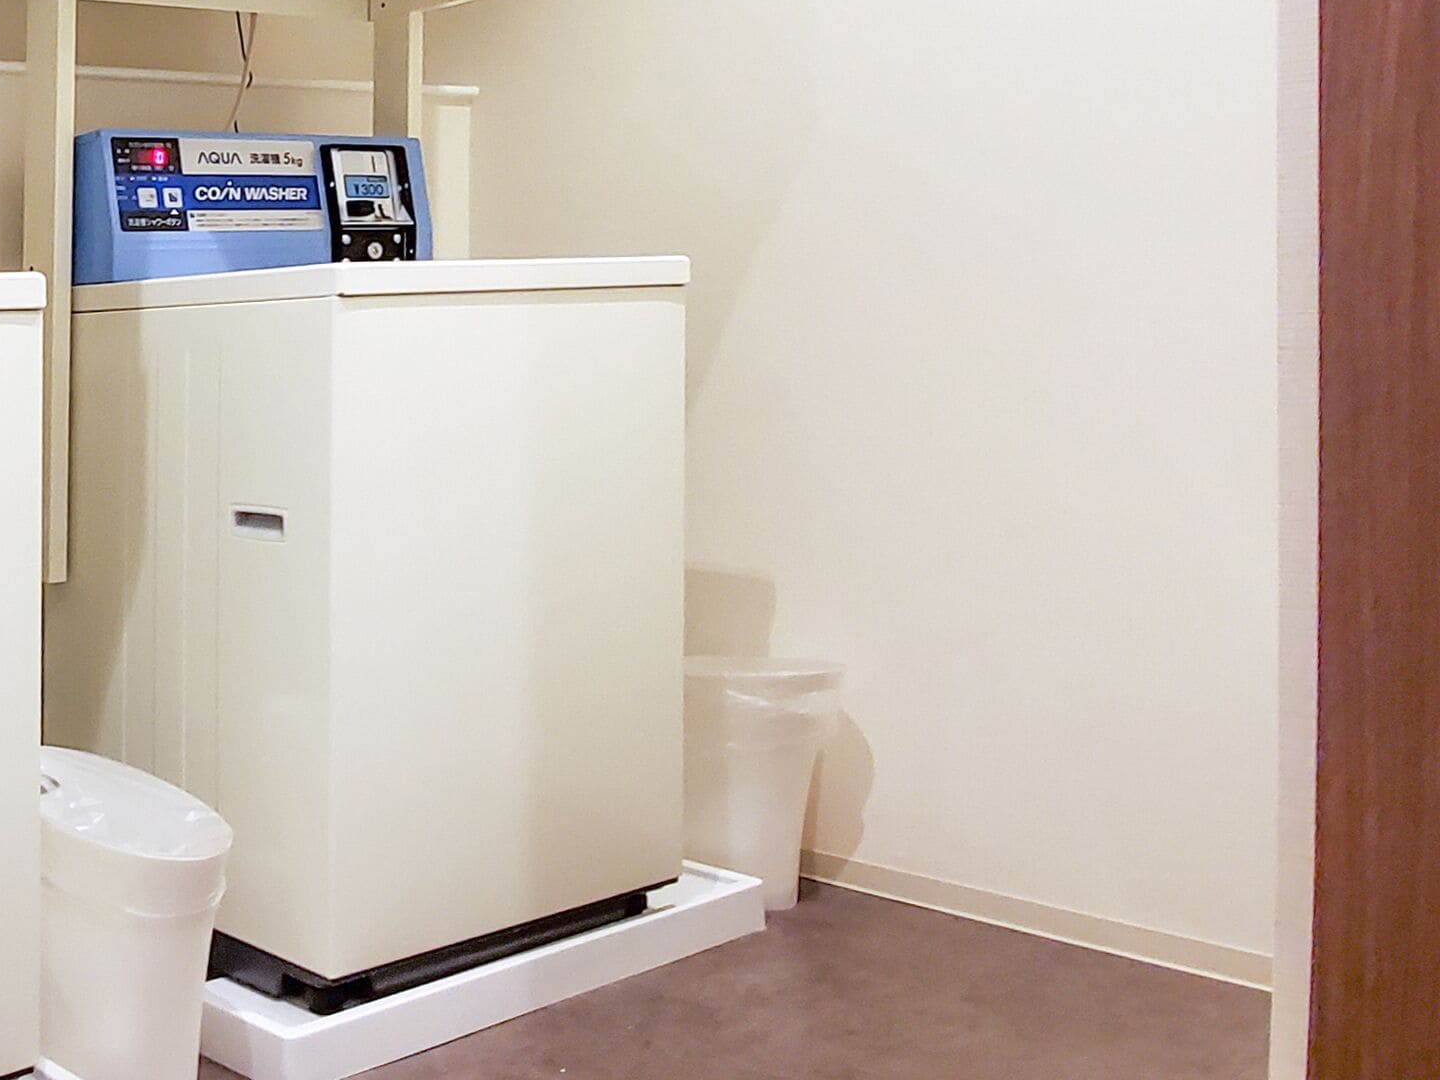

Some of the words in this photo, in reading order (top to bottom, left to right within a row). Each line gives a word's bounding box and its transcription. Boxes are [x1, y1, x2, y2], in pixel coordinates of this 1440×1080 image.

[198, 152, 242, 165] AQUA
[195, 181, 241, 201] COIN
[244, 186, 308, 201] WASHER
